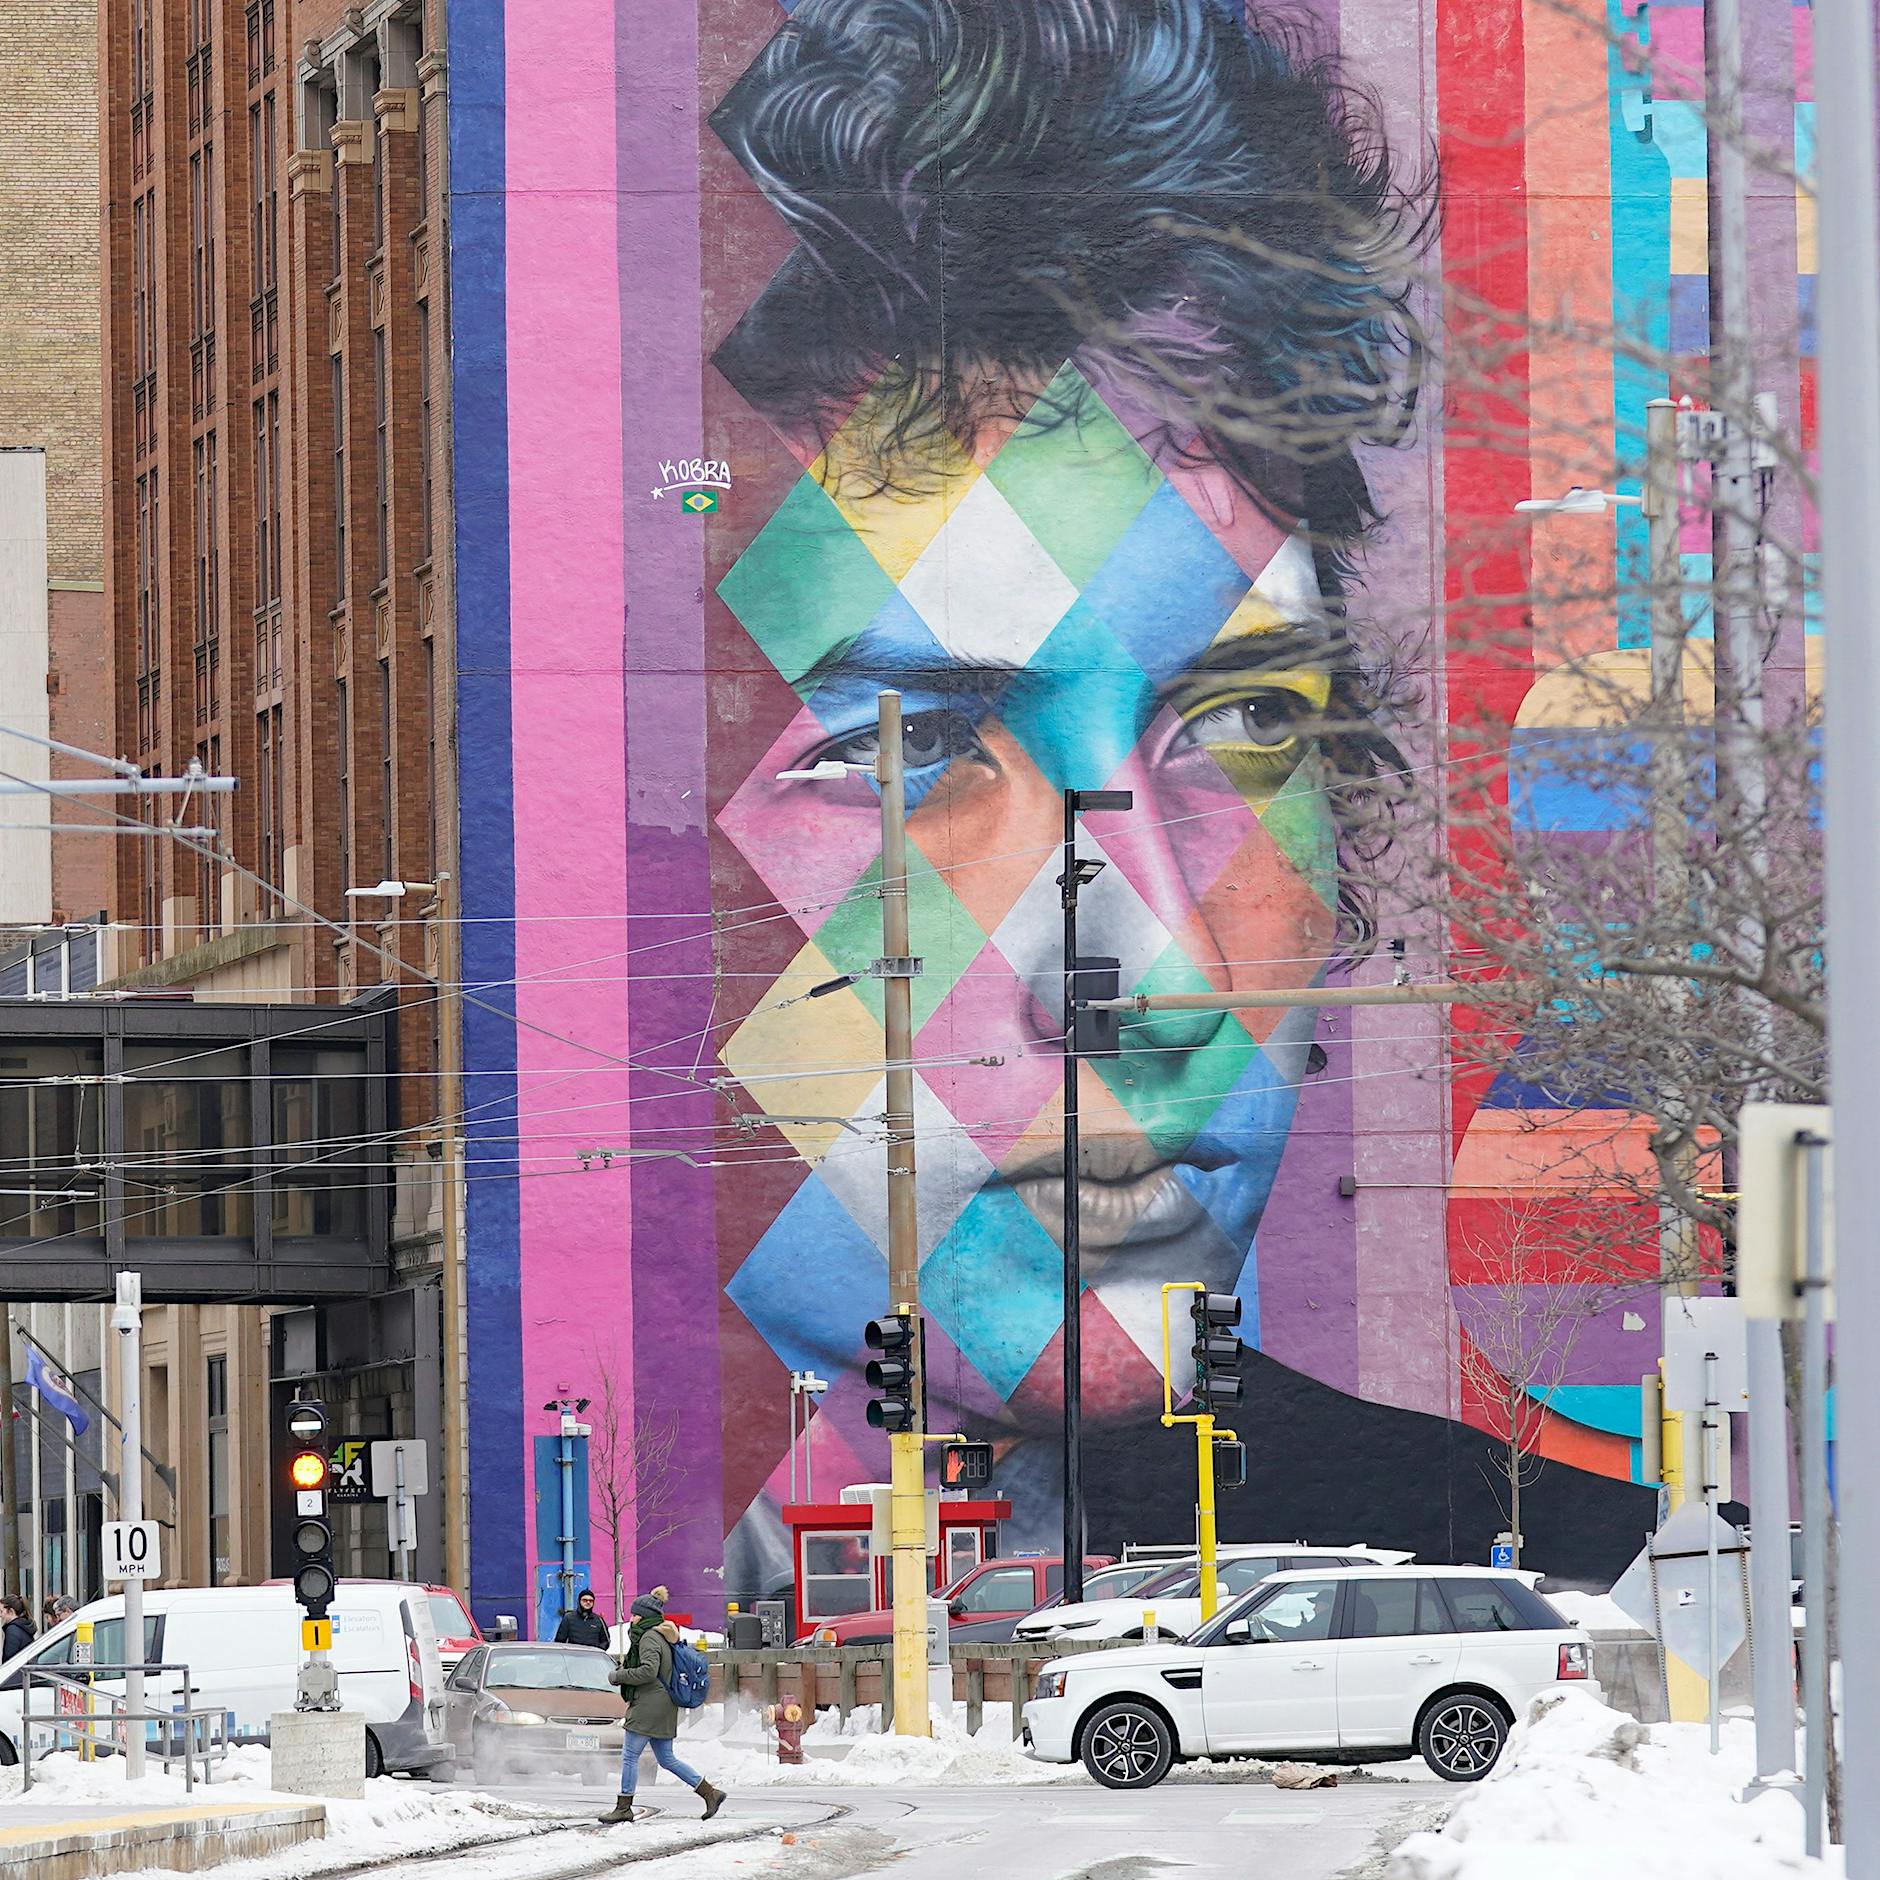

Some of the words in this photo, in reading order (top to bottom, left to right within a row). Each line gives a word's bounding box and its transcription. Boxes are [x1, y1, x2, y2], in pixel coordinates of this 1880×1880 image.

[658, 458, 731, 484] KOBRA
[306, 1498, 313, 1508] 2
[113, 1526, 147, 1561] 10
[119, 1564, 145, 1573] MPH
